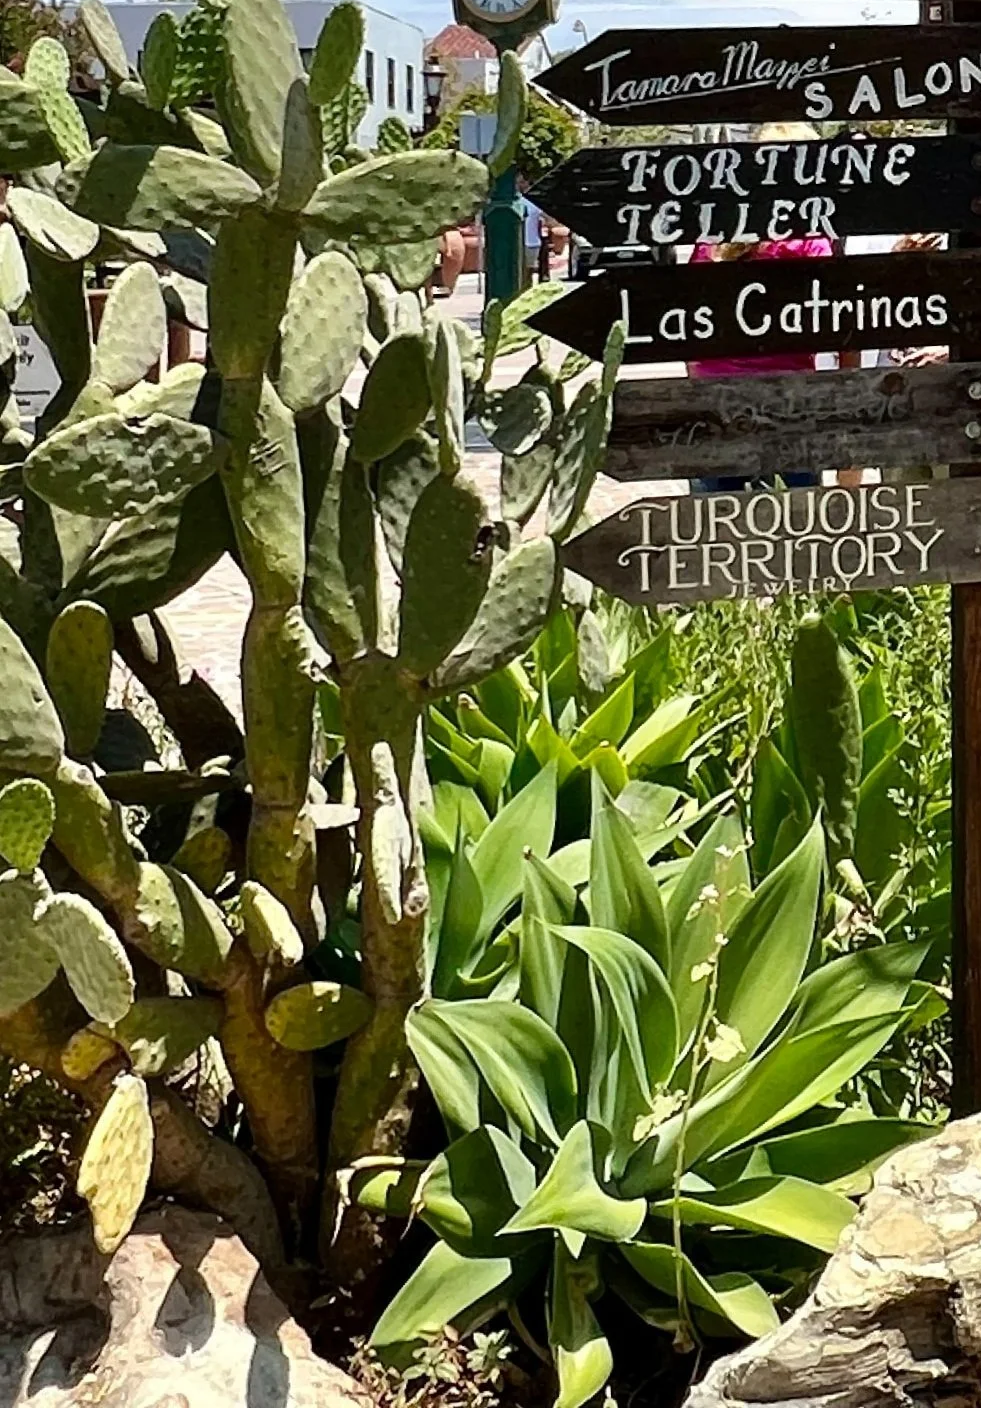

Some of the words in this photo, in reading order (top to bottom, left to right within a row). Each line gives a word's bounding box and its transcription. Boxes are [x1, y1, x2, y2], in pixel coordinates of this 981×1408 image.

[584, 49, 717, 106] Tamara
[621, 143, 916, 197] FORTUNE
[617, 196, 841, 245] TELLER
[619, 289, 715, 344] Las
[735, 279, 949, 337] Catrinas
[619, 484, 937, 545] TURQUOISE
[618, 529, 944, 592] TERRITORY
[725, 575, 857, 599] JEWELRY
